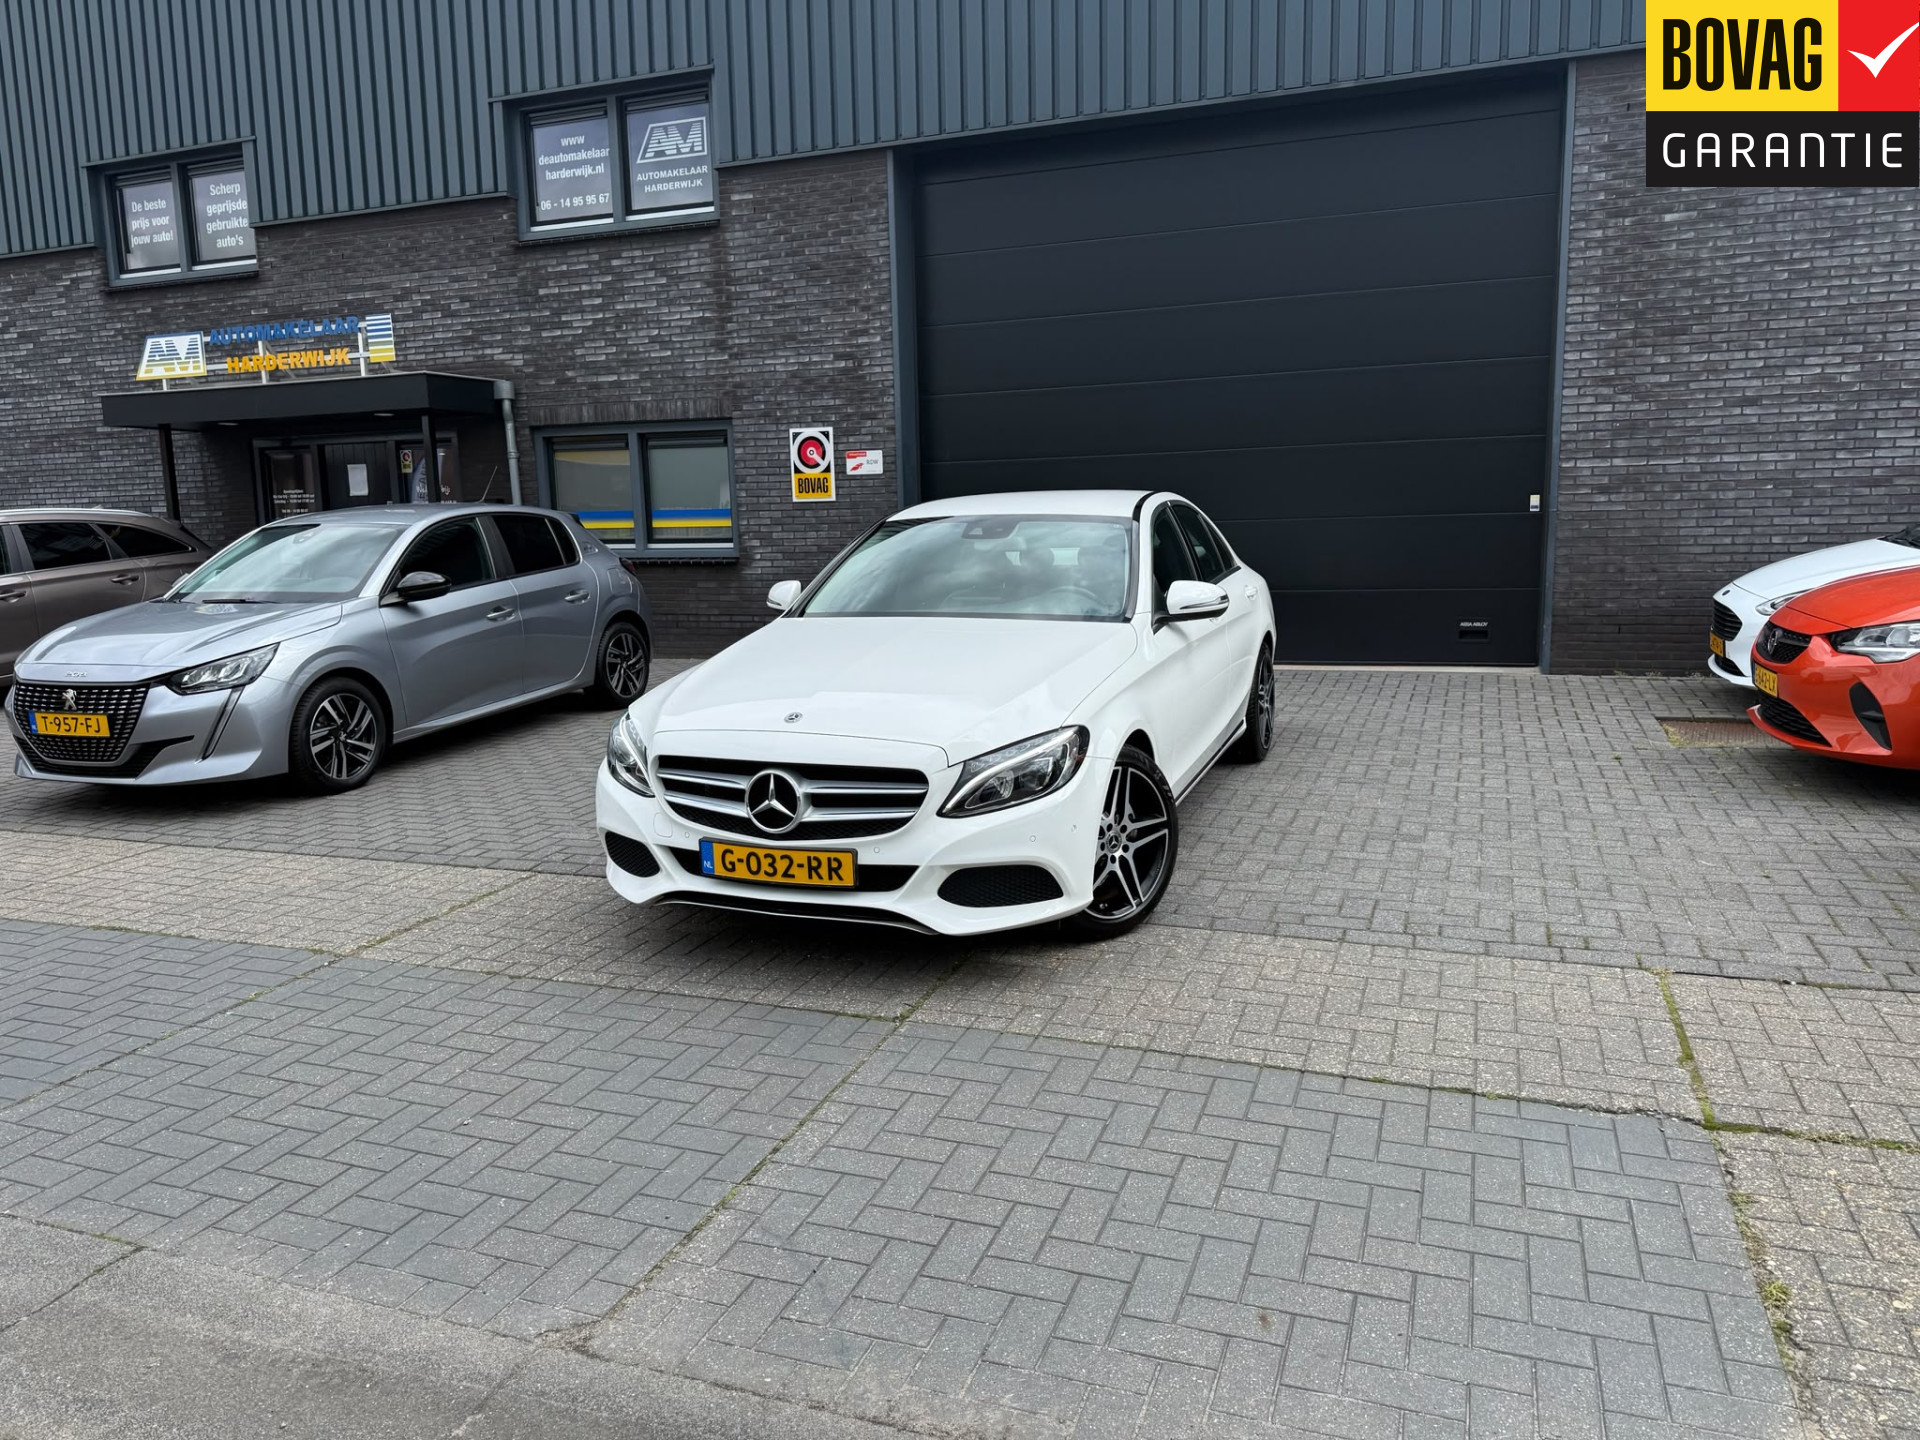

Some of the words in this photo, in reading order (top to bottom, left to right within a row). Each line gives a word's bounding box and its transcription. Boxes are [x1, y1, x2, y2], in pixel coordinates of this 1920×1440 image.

[560, 135, 585, 147] www
[538, 147, 610, 166] deautomakelaar
[545, 163, 605, 181] harderwijk.nl
[636, 165, 708, 181] AUTOMAKELAAR
[209, 182, 241, 196] Scherp
[644, 178, 703, 193] HARDERWIJK
[131, 201, 143, 213] De
[144, 198, 167, 210] beste
[206, 199, 248, 217] geprijsde
[540, 198, 552, 211] 06
[560, 197, 571, 208] 14
[572, 196, 584, 207] 95
[585, 194, 597, 206] 95
[598, 192, 610, 204] 67
[131, 219, 150, 231] prijs
[151, 216, 170, 227] voor
[206, 216, 249, 234] gebruikte
[131, 234, 151, 248] jouw
[152, 230, 174, 242] auto!
[216, 234, 244, 249] auto's
[209, 316, 360, 346] AUTOMAKELAAR
[227, 347, 351, 374] HARDERWIJK
[798, 477, 829, 494] BOVAG
[41, 716, 101, 733] T-957-FJ
[703, 860, 713, 869] NL
[721, 848, 844, 881] G-032-RR
